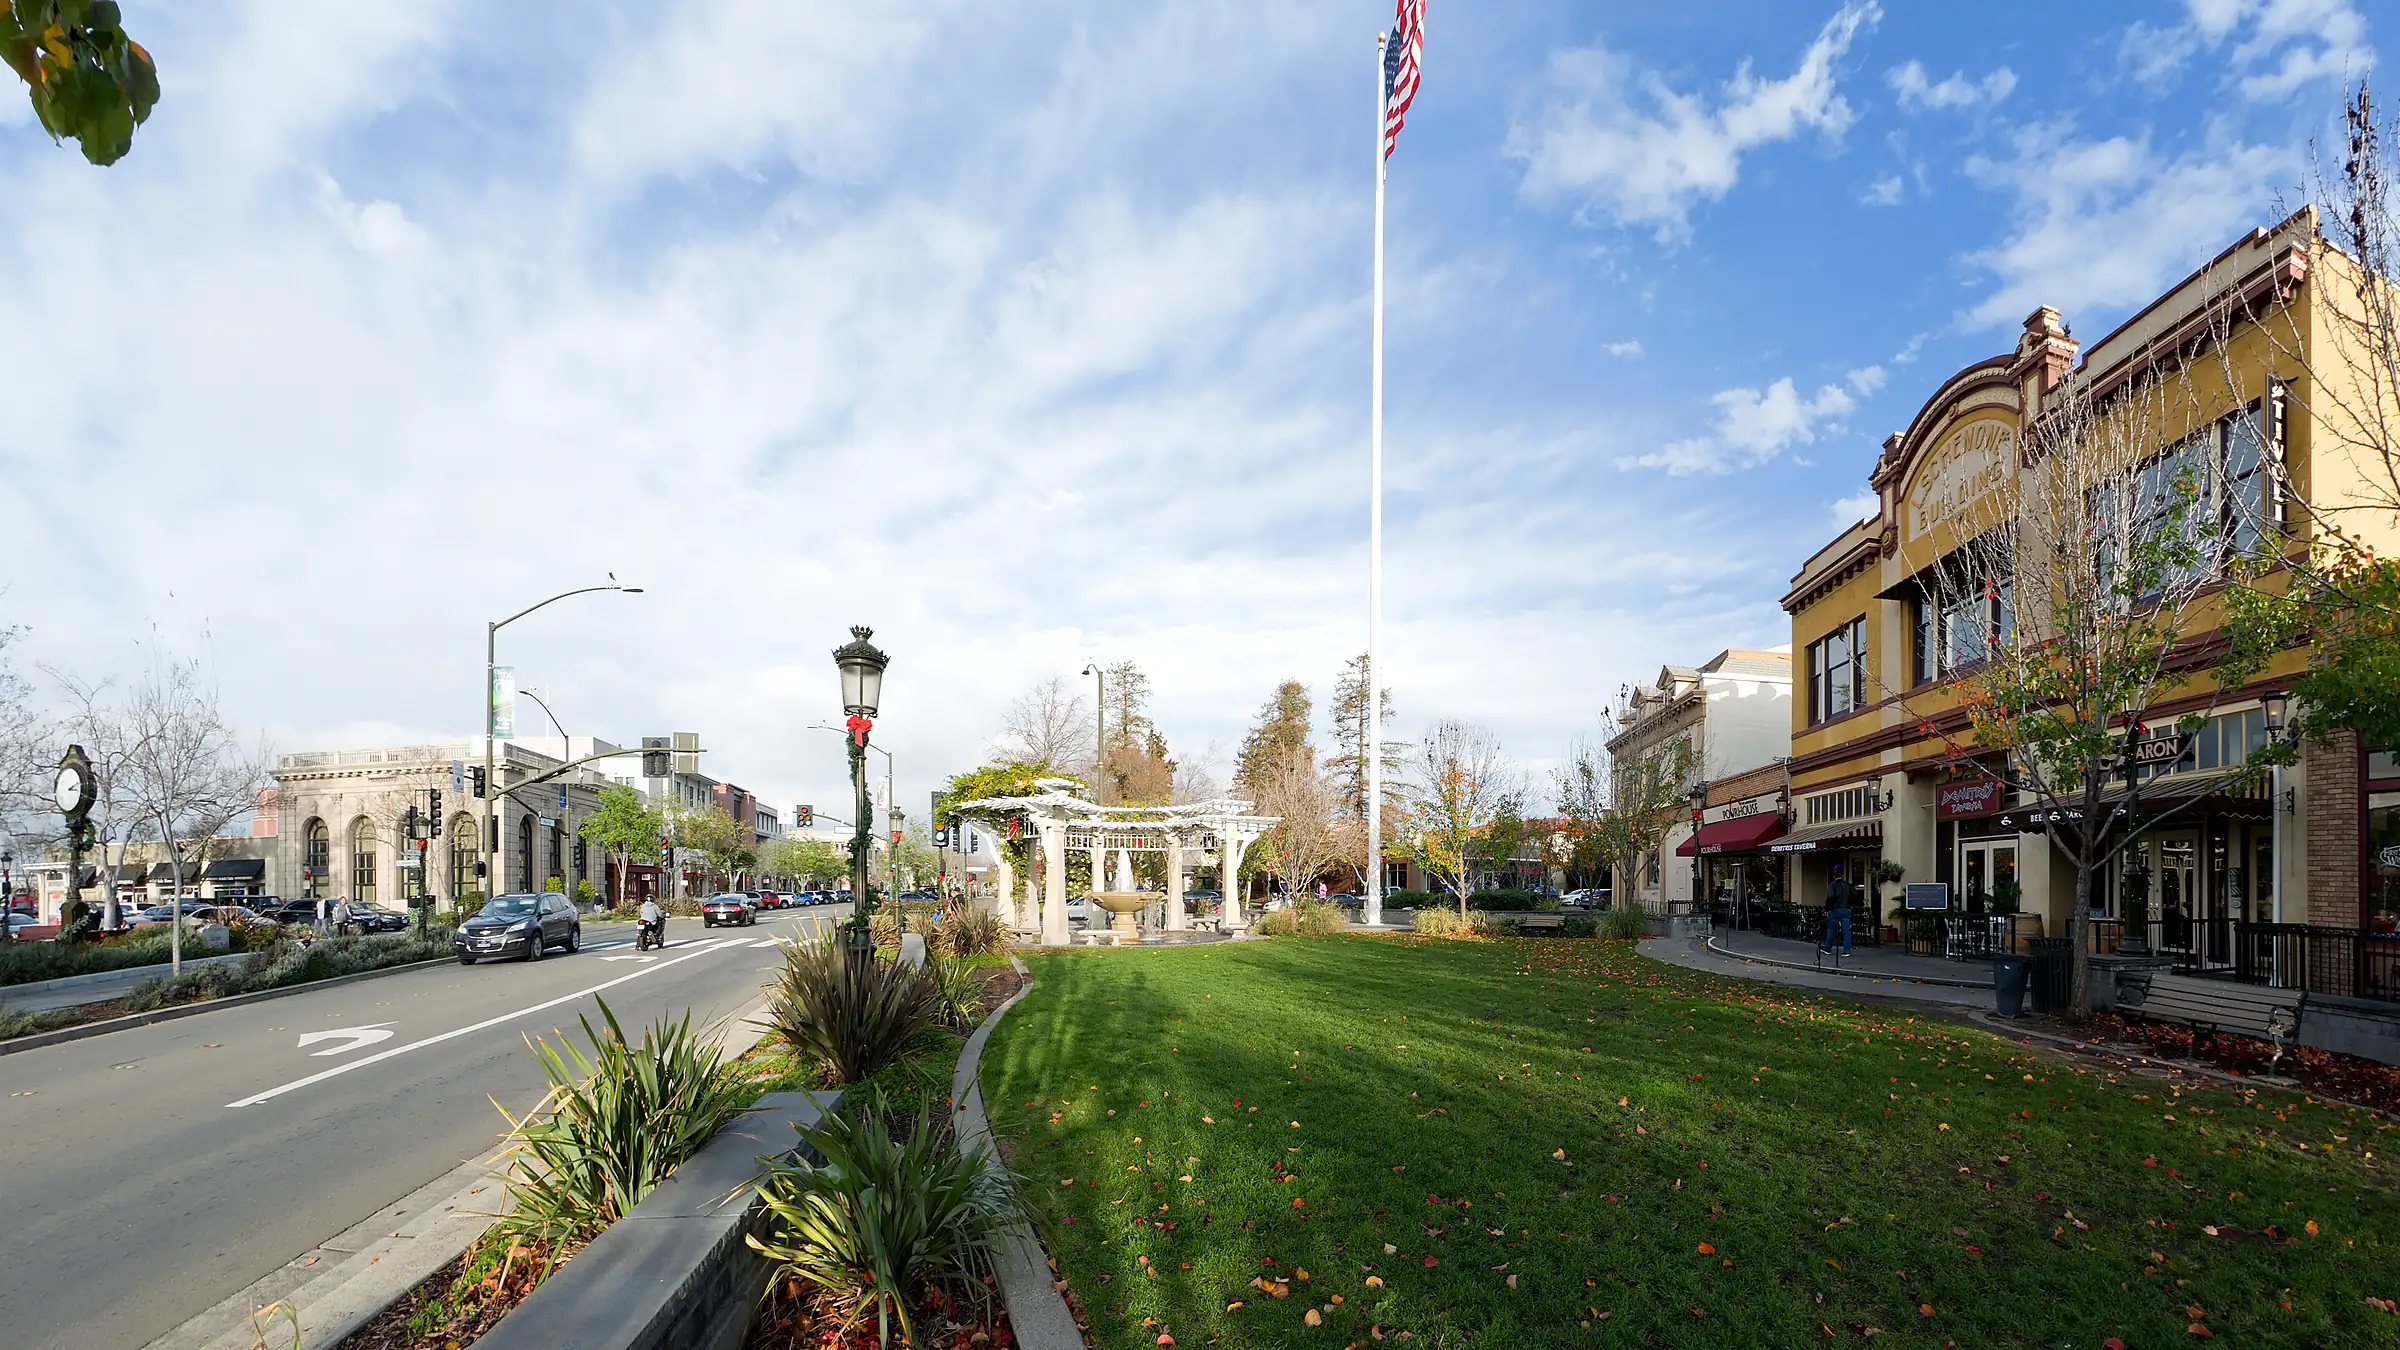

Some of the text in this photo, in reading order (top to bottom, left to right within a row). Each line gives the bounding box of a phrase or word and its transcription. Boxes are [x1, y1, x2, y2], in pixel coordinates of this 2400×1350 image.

[2136, 738, 2178, 760] ARON
[1722, 802, 1759, 820] POURHOUSE
[2030, 813, 2043, 823] BEE
